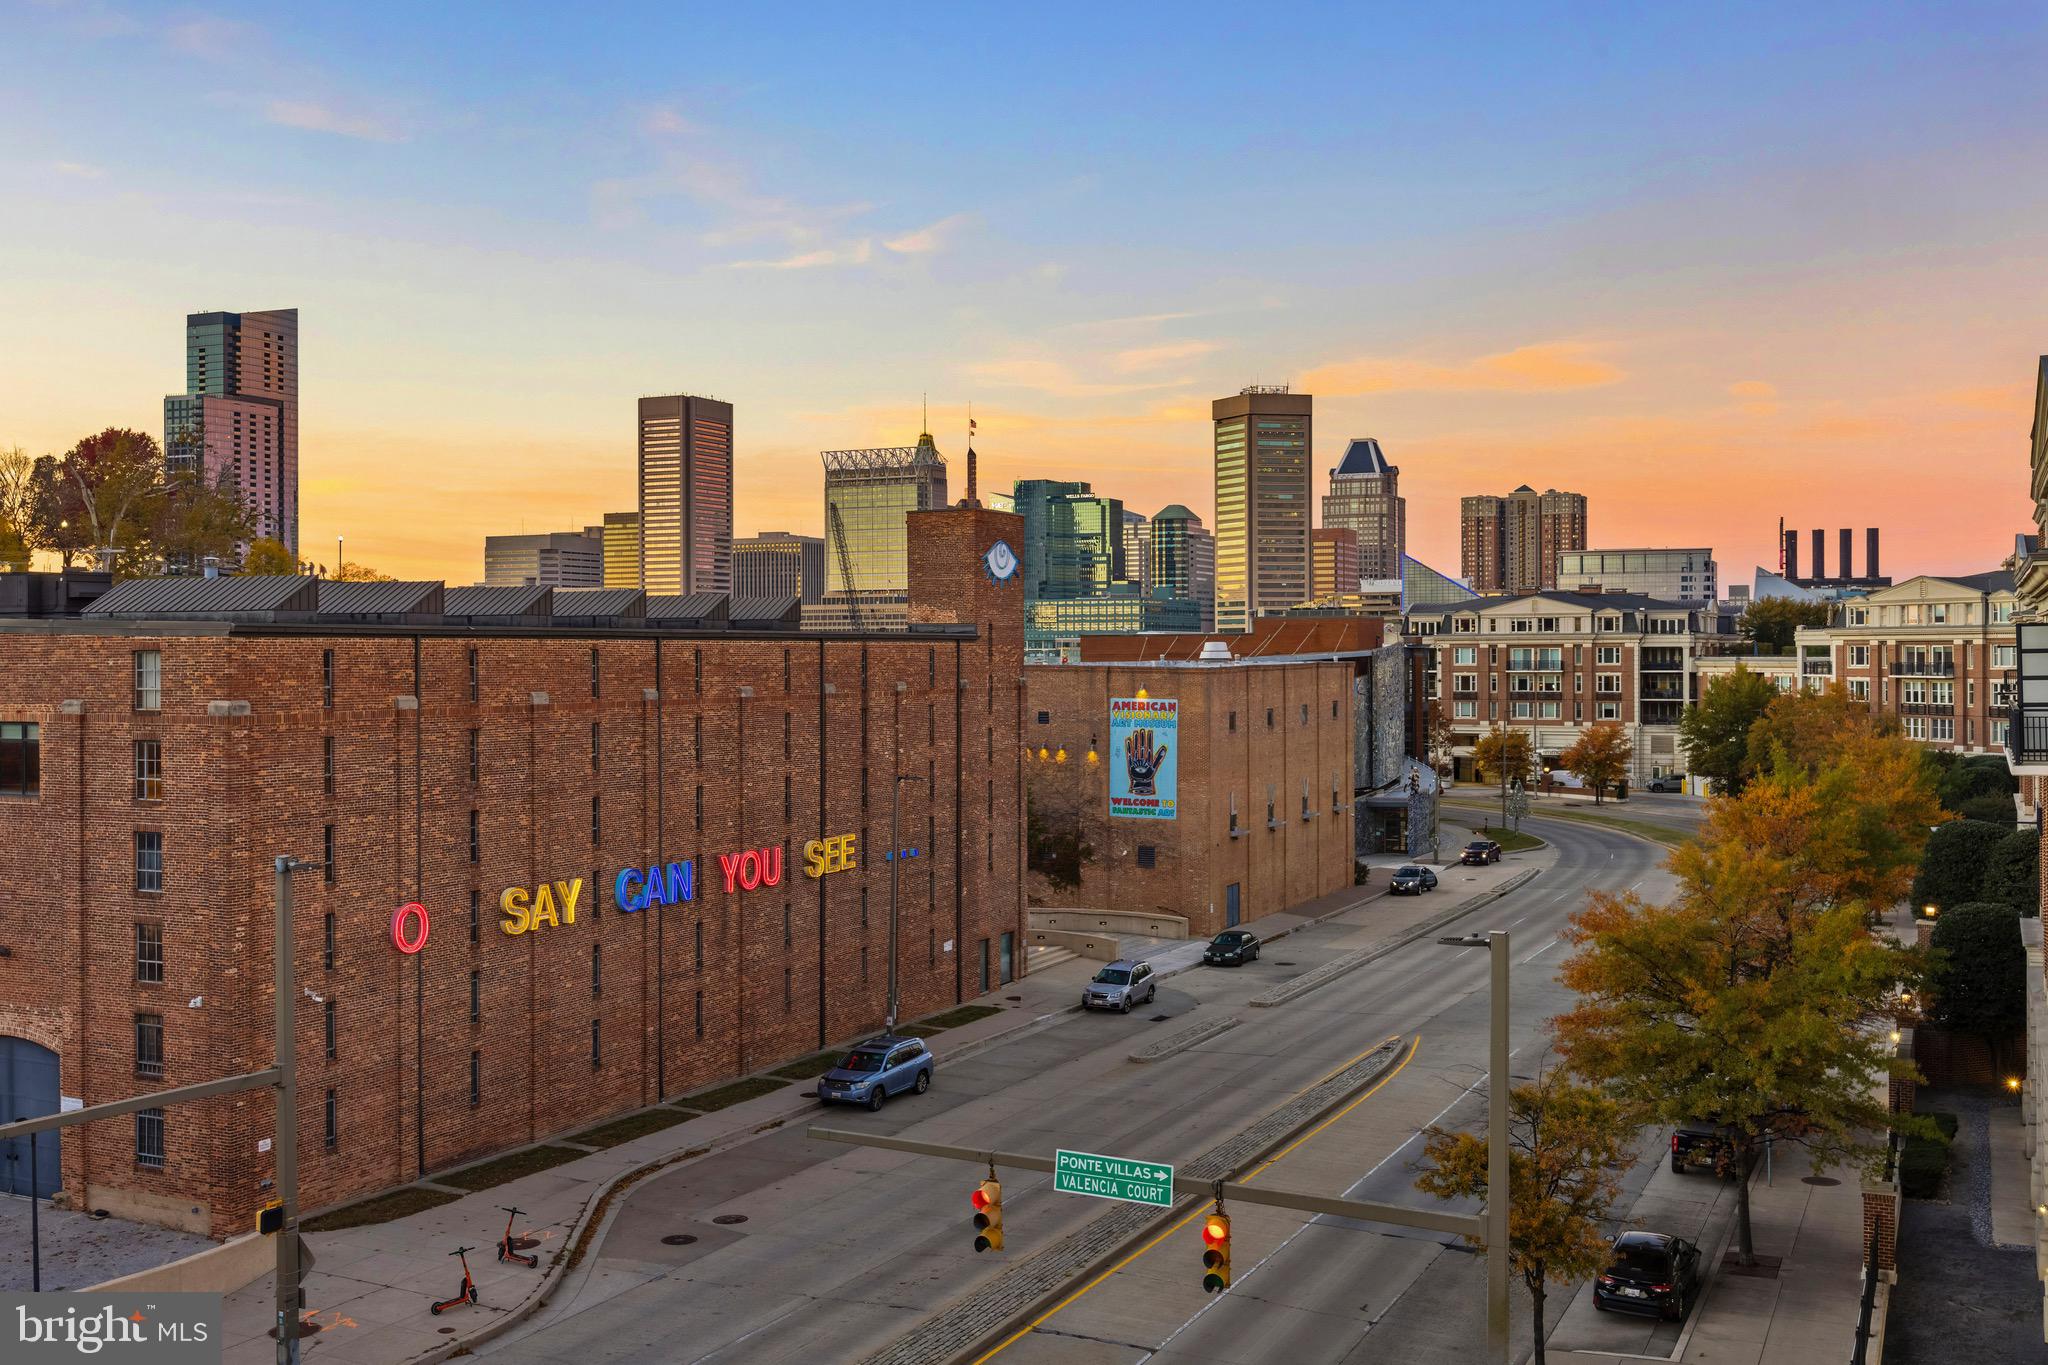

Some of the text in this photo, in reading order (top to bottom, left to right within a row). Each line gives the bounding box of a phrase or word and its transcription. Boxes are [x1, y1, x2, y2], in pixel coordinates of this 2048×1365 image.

[1111, 701, 1177, 711] AMERICAN
[1112, 711, 1175, 719] VISIONARY
[1111, 719, 1176, 728] ART MUSEUM
[1111, 797, 1175, 808] WELCOME TO
[1112, 807, 1157, 816] FANTASTIC
[390, 901, 430, 954] O
[499, 877, 583, 935] SAY
[614, 860, 692, 913] CAN
[717, 845, 782, 894] YOU
[803, 833, 857, 879] SEE
[1060, 1156, 1151, 1179] PONTE VILLAS
[1062, 1174, 1164, 1201] VALENCIA COURT
